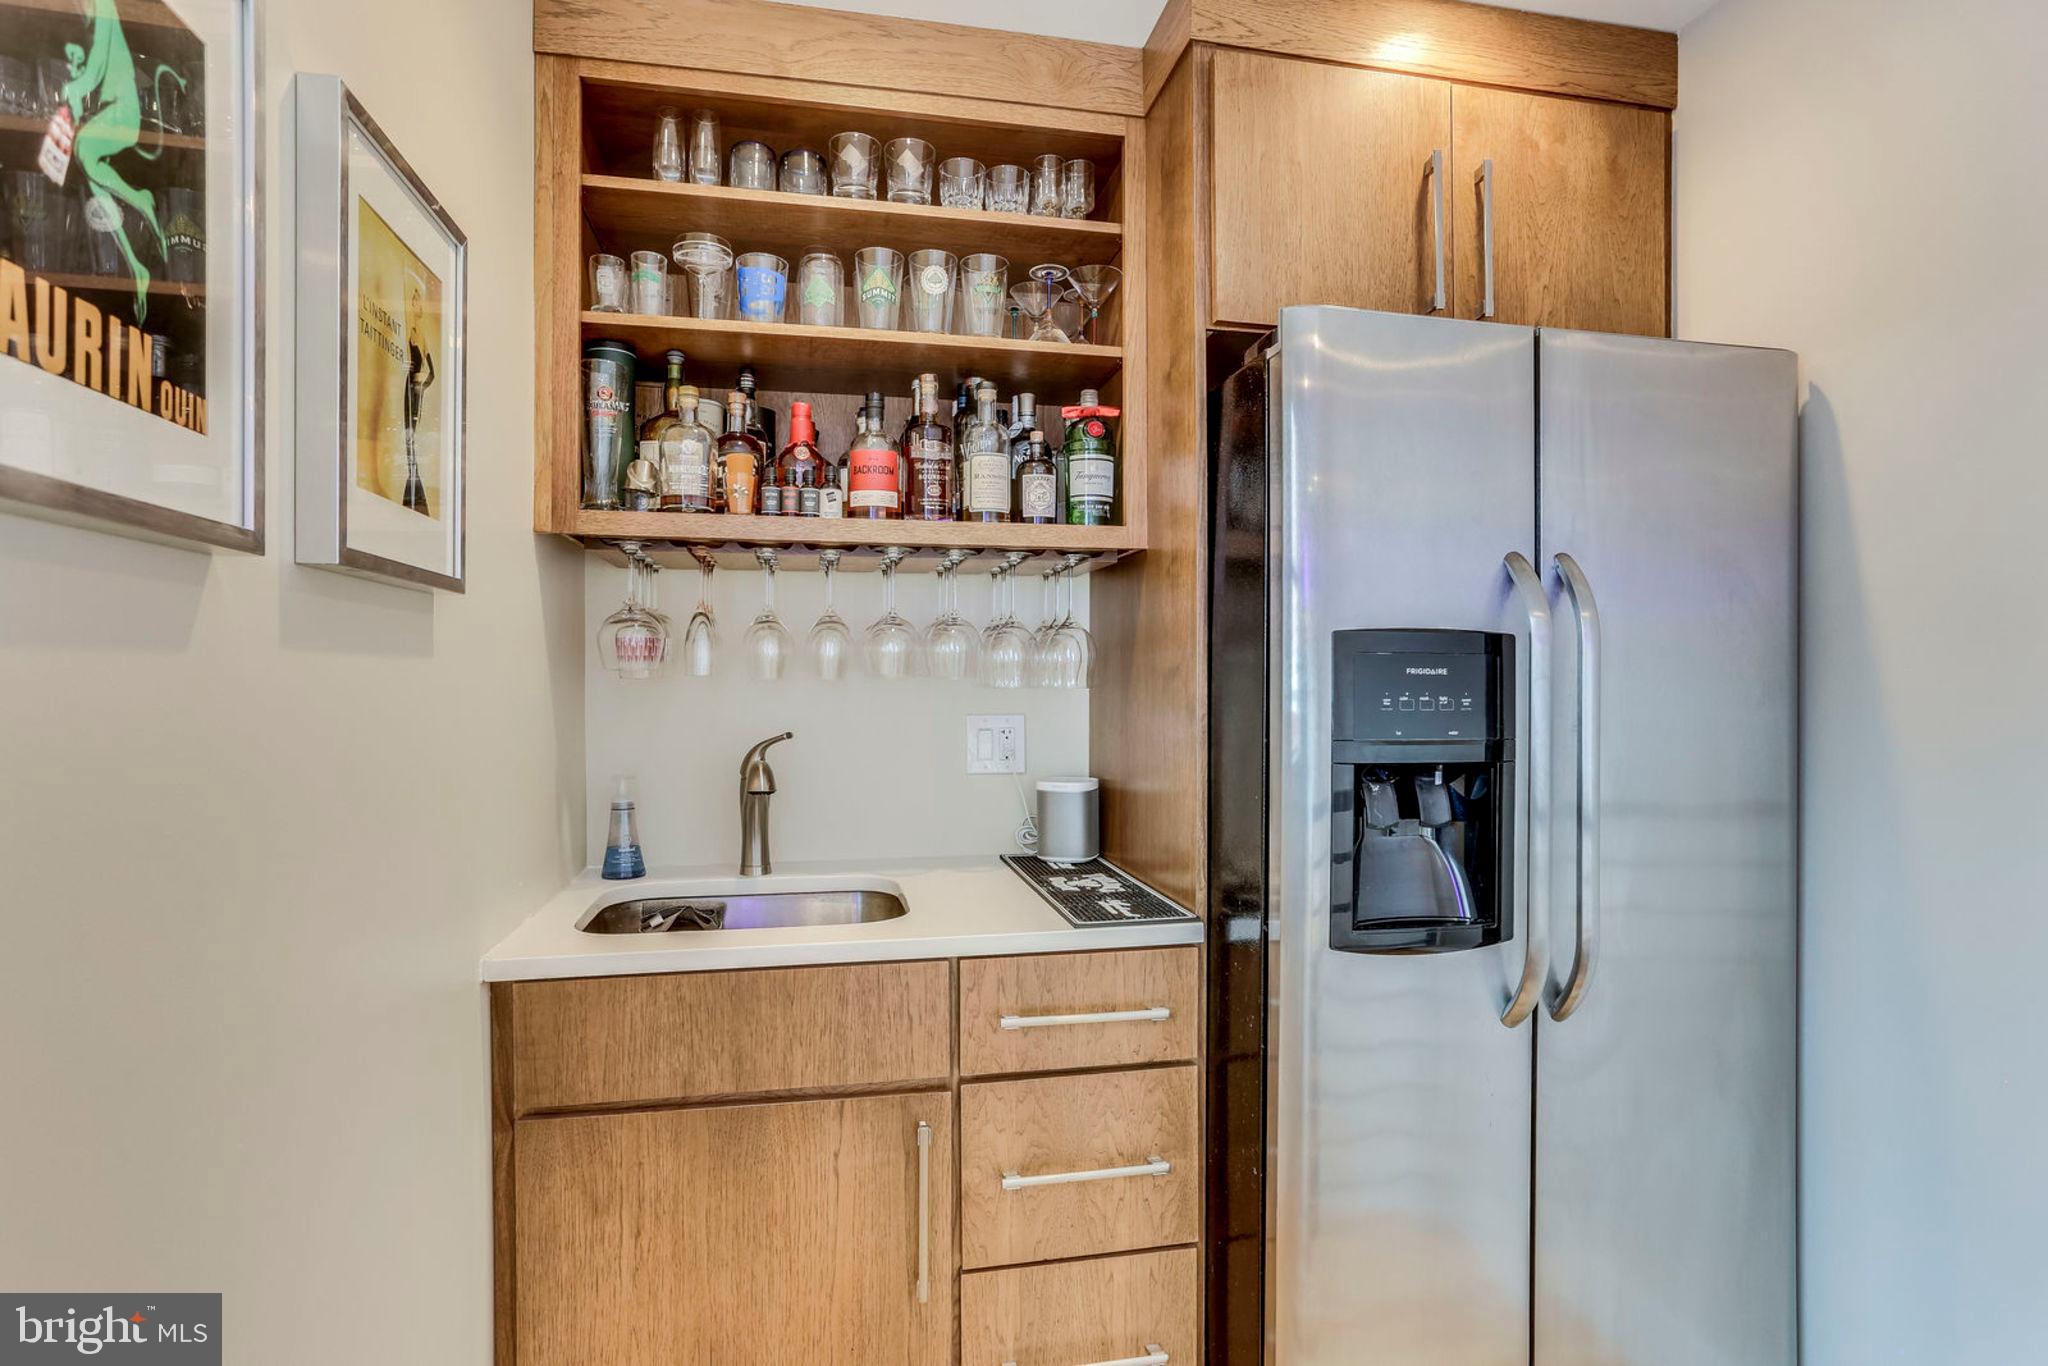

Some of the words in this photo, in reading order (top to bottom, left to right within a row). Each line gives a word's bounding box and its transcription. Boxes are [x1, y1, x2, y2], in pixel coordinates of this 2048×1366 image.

[862, 287, 896, 304] SUMMIT
[363, 294, 402, 336] L'INSTANT
[360, 316, 404, 363] TAITTINGER
[854, 464, 895, 475] BACKROOM
[1406, 667, 1448, 676] FRIGIDAIRE
